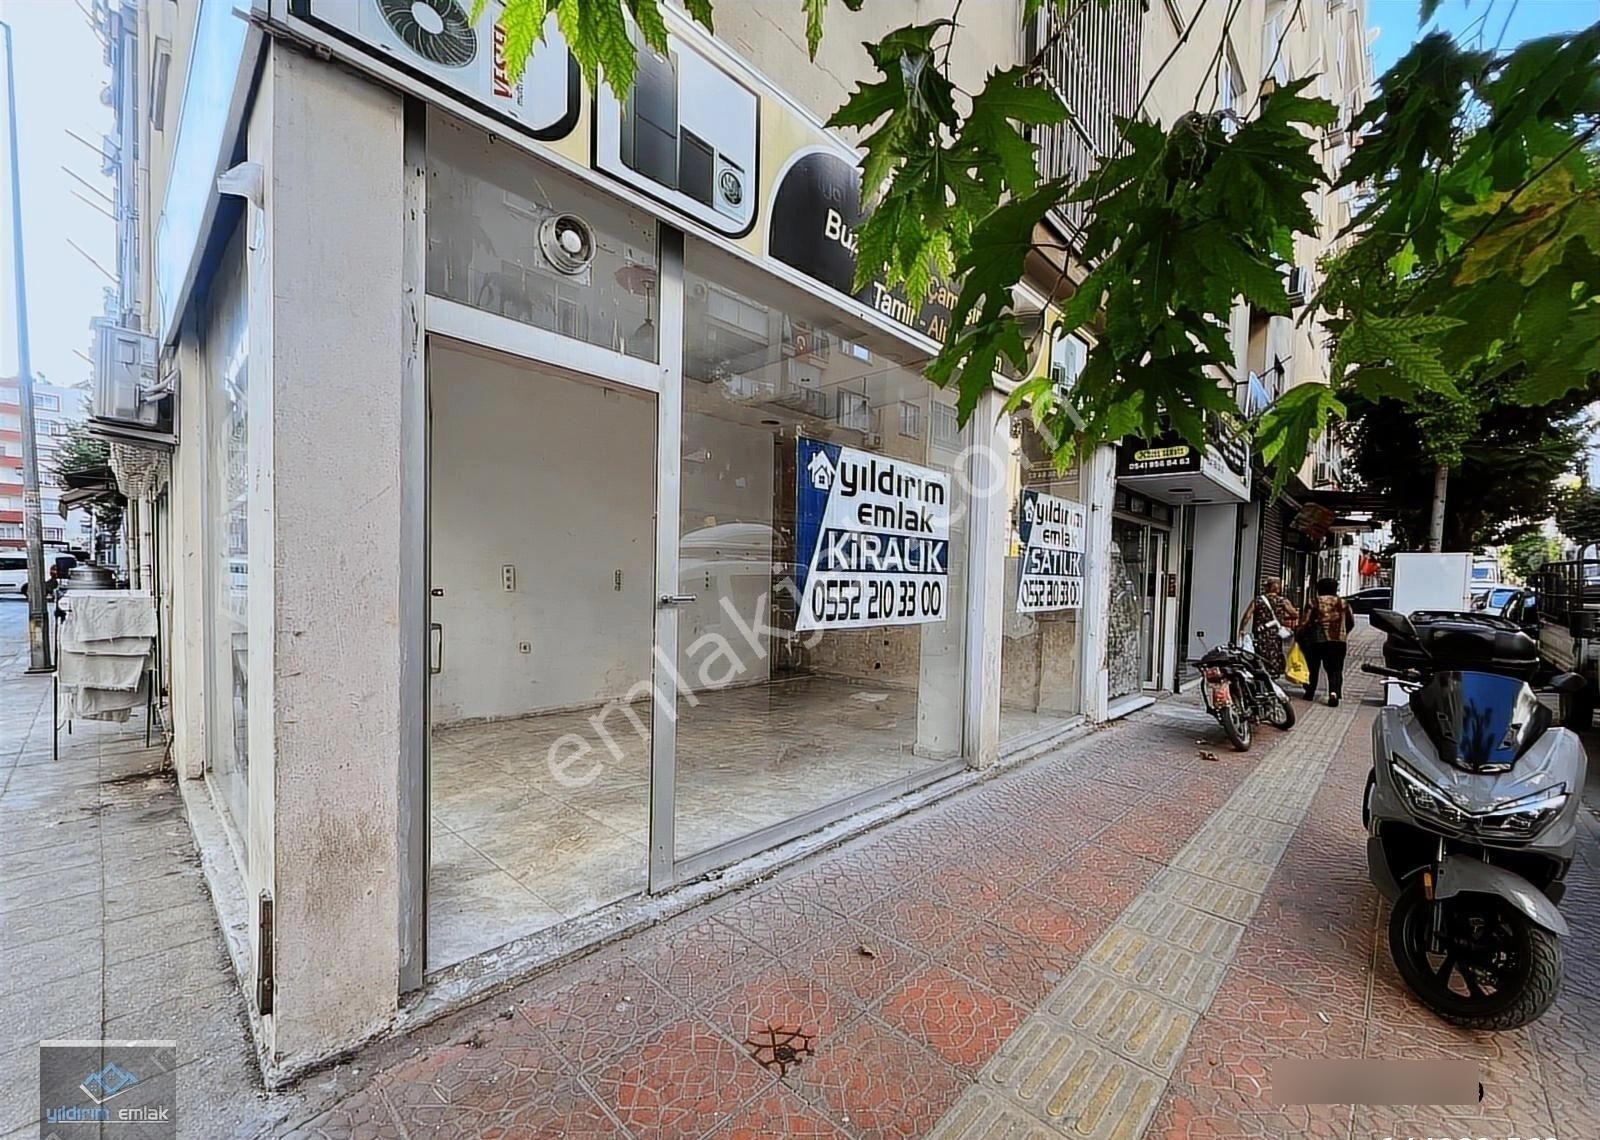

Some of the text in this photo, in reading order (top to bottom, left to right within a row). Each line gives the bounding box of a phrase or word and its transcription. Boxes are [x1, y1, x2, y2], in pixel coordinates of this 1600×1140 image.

[873, 281, 915, 327] Tamir
[840, 459, 945, 505] yıldırım
[857, 501, 934, 534] emlak
[1042, 526, 1078, 548] emlak
[812, 579, 941, 622] 0552 210 33 00
